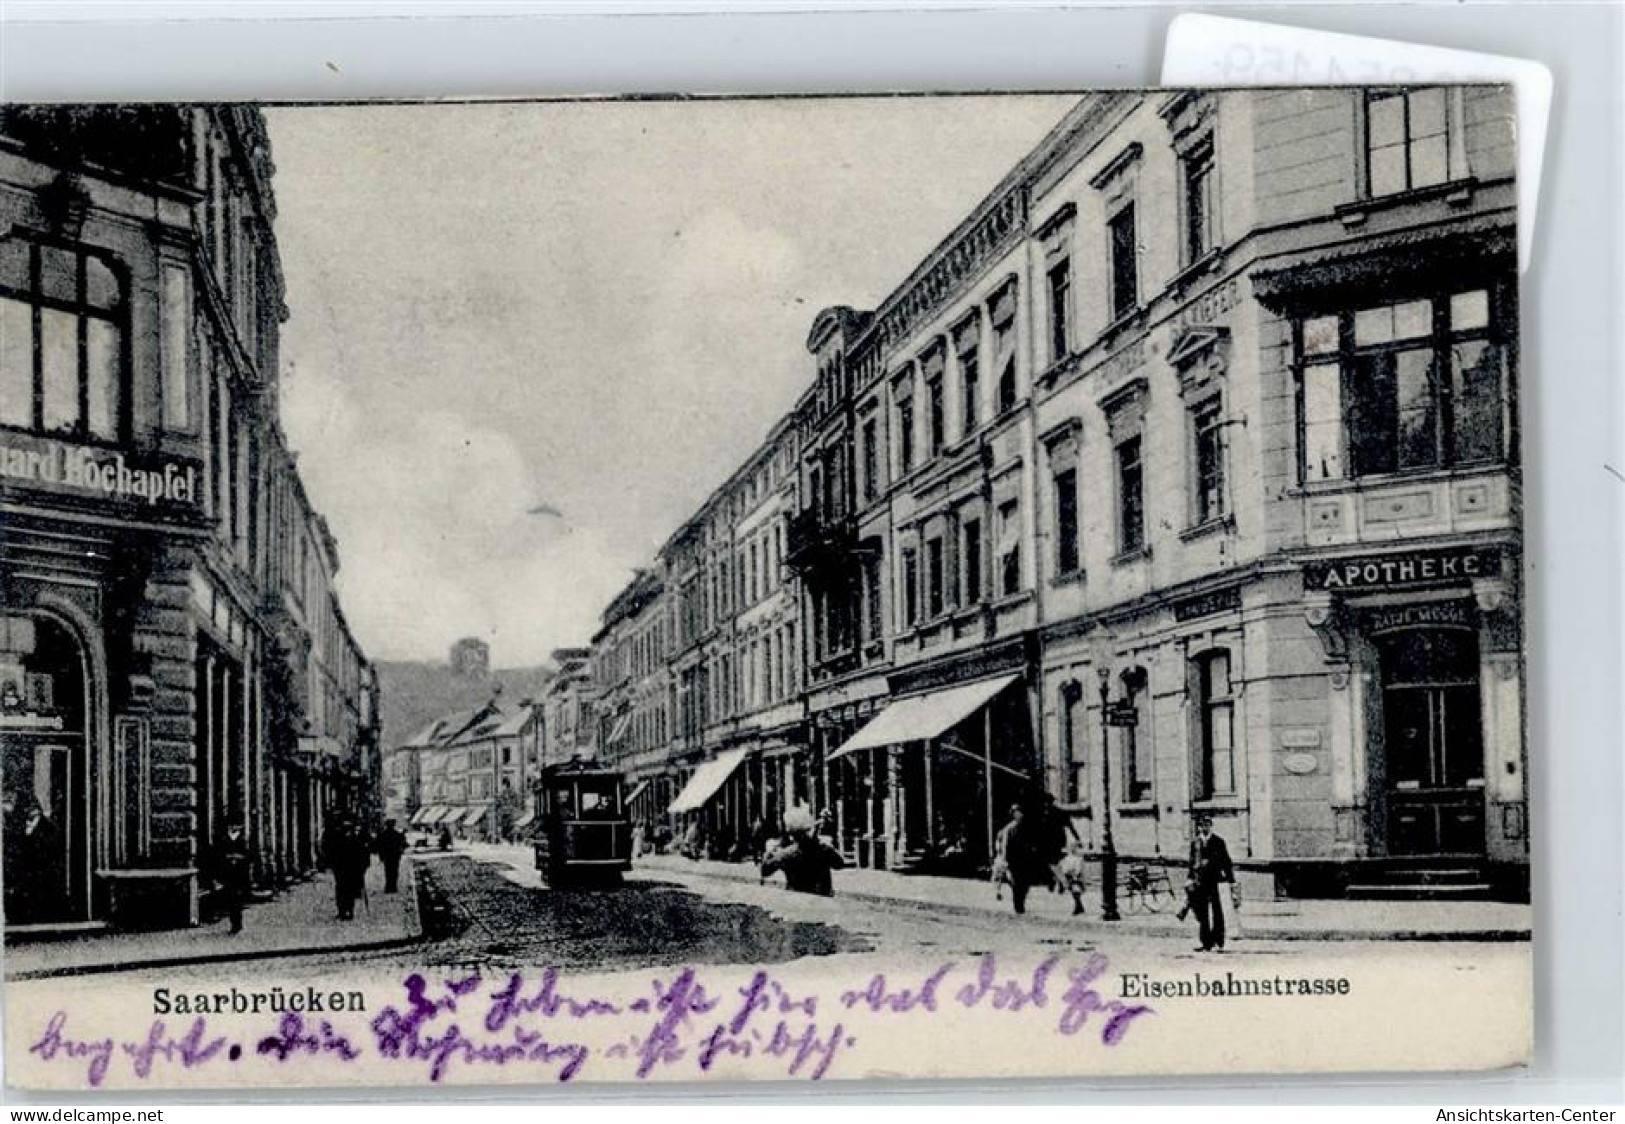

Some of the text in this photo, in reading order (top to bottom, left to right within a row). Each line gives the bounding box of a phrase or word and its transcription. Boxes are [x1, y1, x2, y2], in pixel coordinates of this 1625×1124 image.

[62, 446, 195, 504] Hochapfel
[1323, 555, 1480, 588] APOTHEKE
[153, 986, 366, 1013] Saarbrücken
[1120, 972, 1350, 998] Eisenbahnstrasse
